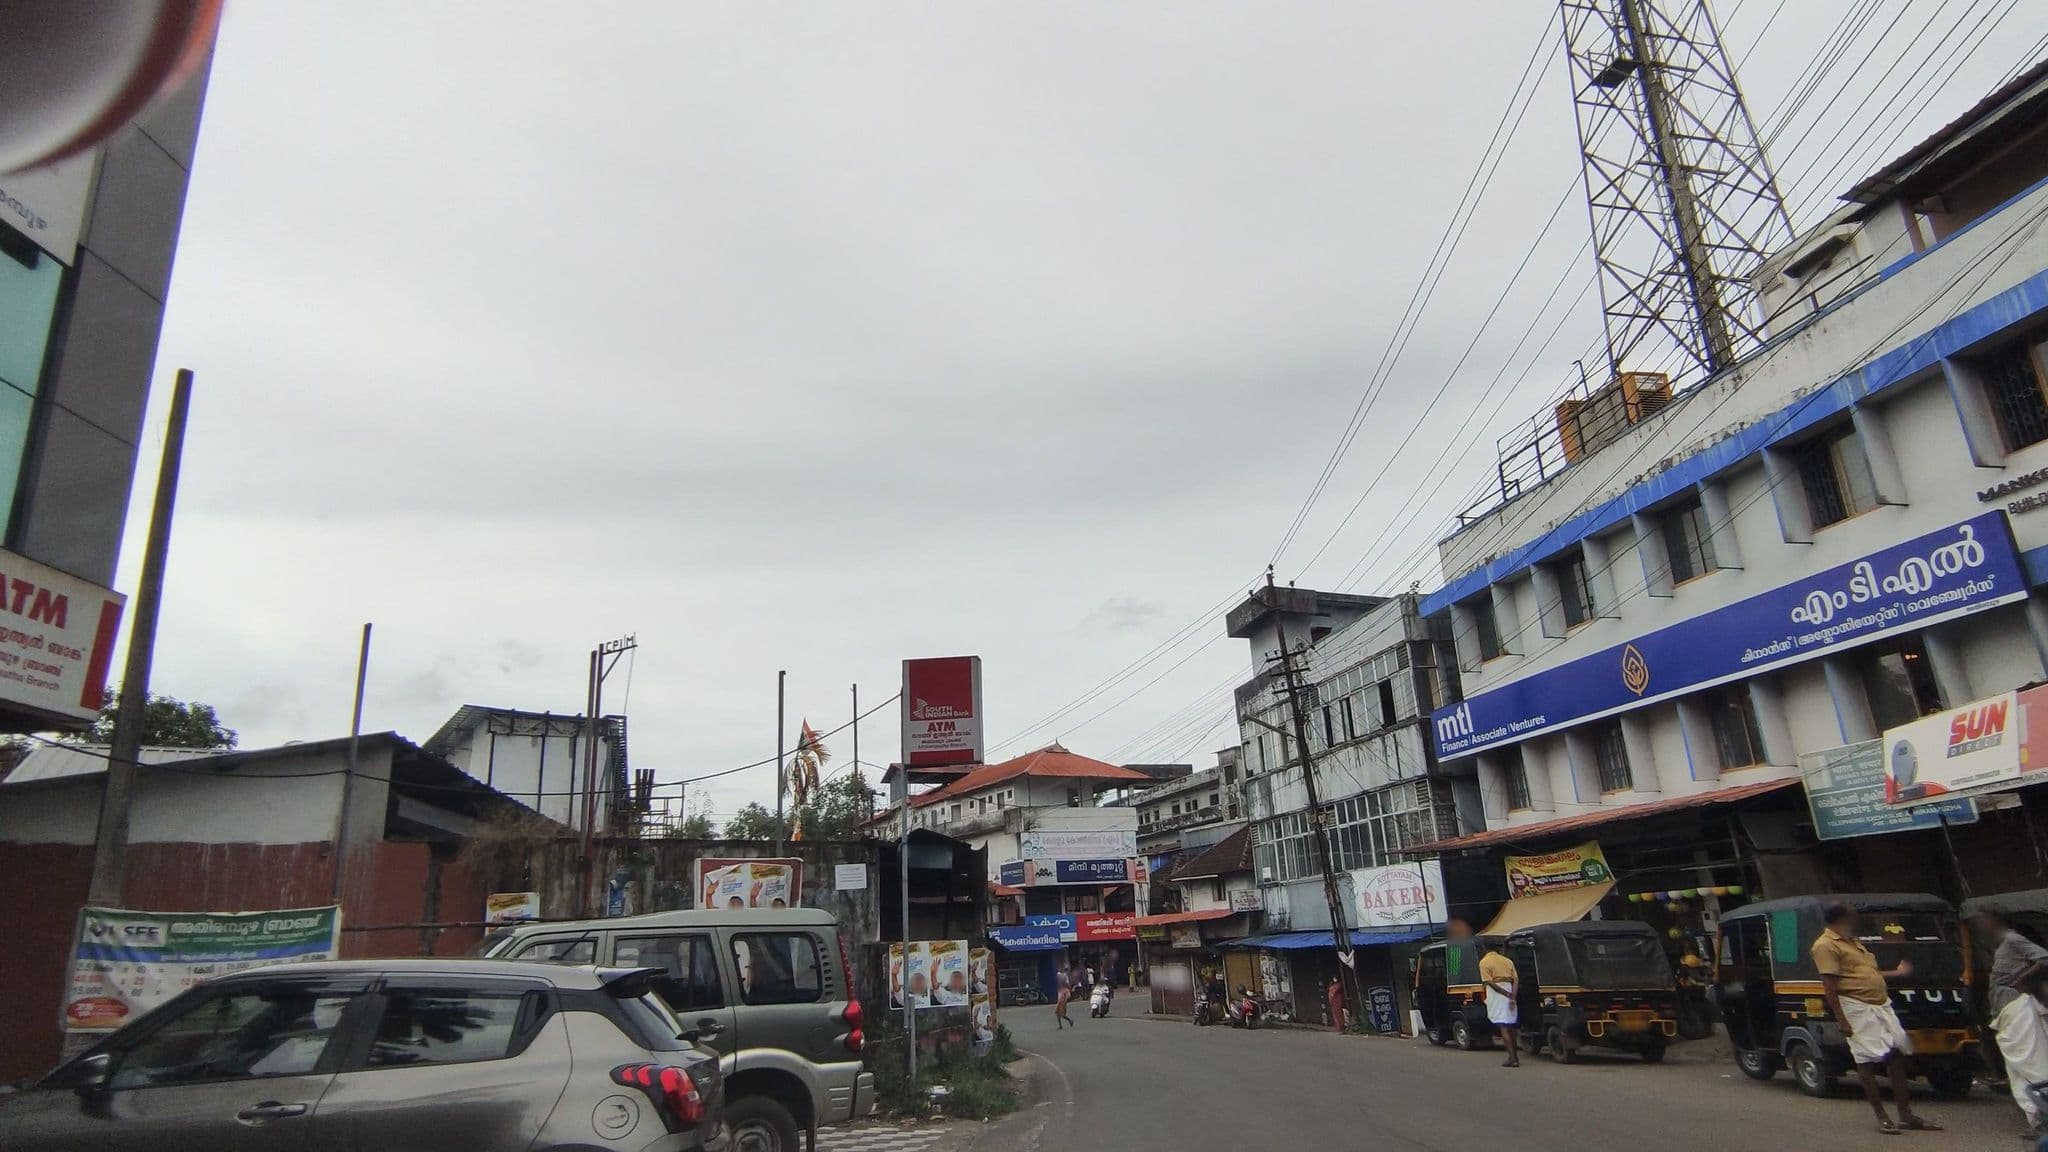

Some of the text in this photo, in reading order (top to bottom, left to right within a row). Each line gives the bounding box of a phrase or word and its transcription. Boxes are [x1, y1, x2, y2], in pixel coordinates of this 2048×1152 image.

[927, 721, 956, 732] ATM
[1437, 702, 1474, 742] mtl
[1442, 714, 1545, 753] Finance Associate Ventures
[1949, 699, 2008, 746] SUN
[1362, 884, 1435, 910] BAKERS
[1898, 989, 1963, 1003] TUL
